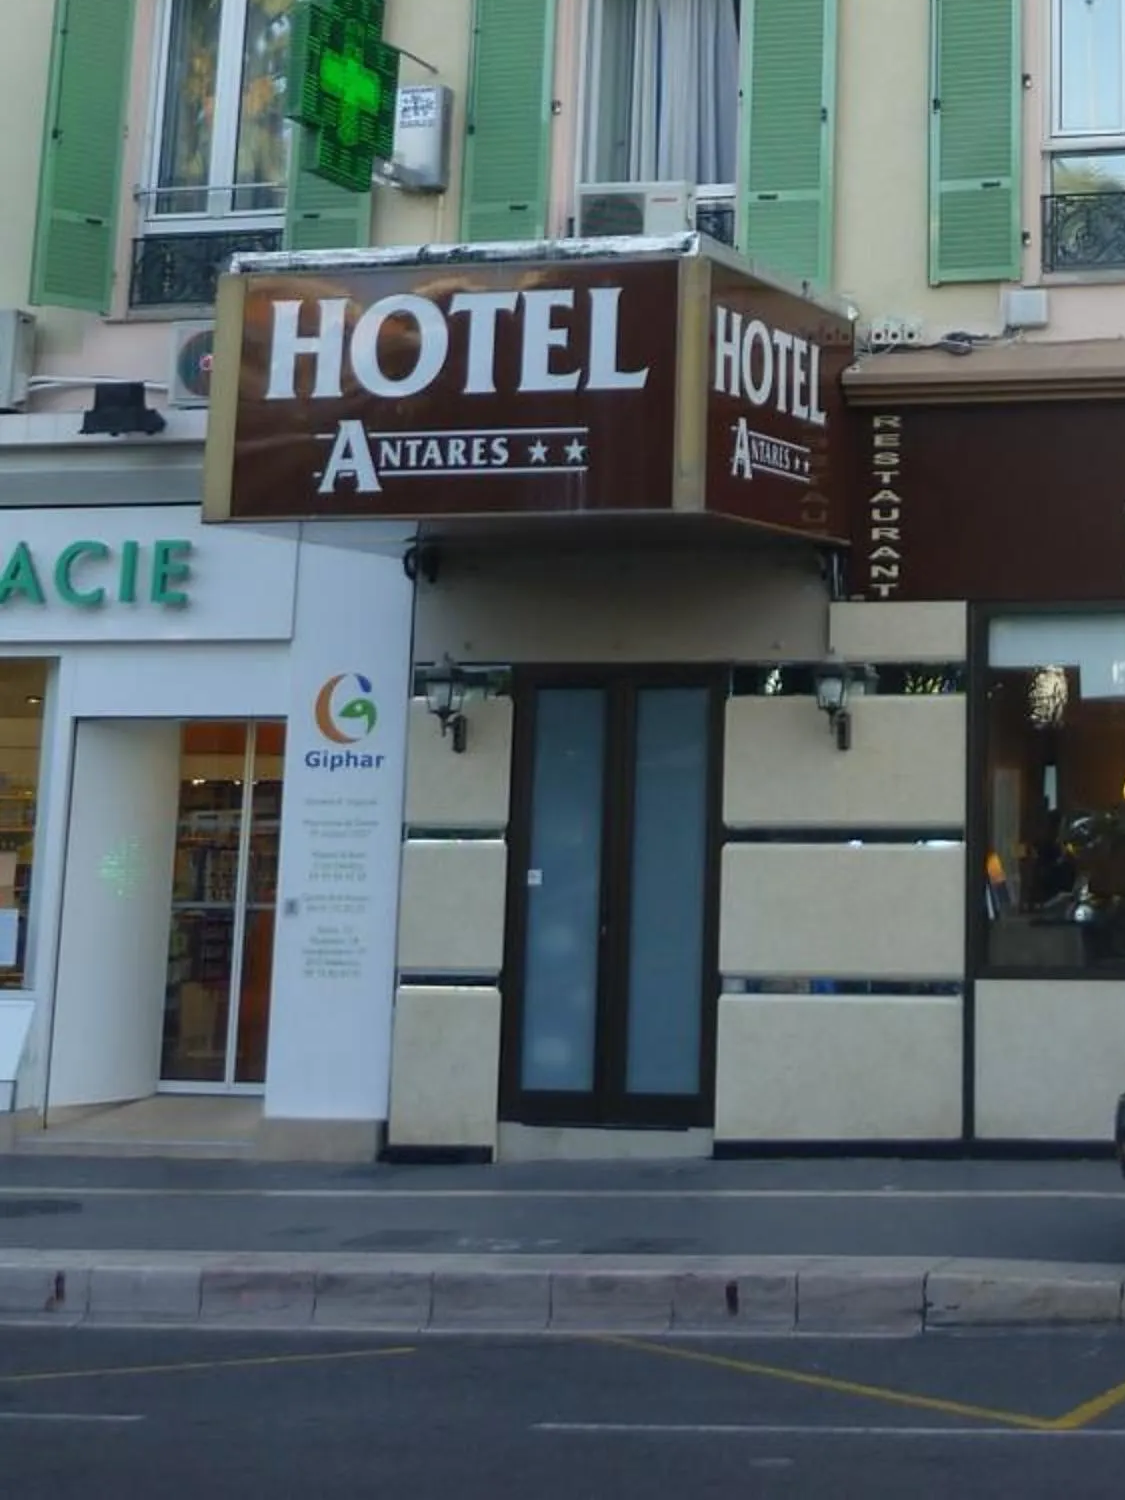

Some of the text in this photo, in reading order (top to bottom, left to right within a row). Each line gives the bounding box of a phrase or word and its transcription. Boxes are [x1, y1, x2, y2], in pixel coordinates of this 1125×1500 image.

[265, 287, 650, 399] HOTEL
[714, 306, 827, 425] HOTEL
[870, 415, 902, 597] RESTAURANT
[0, 539, 192, 607] ACIE
[304, 750, 385, 772] Giphar
